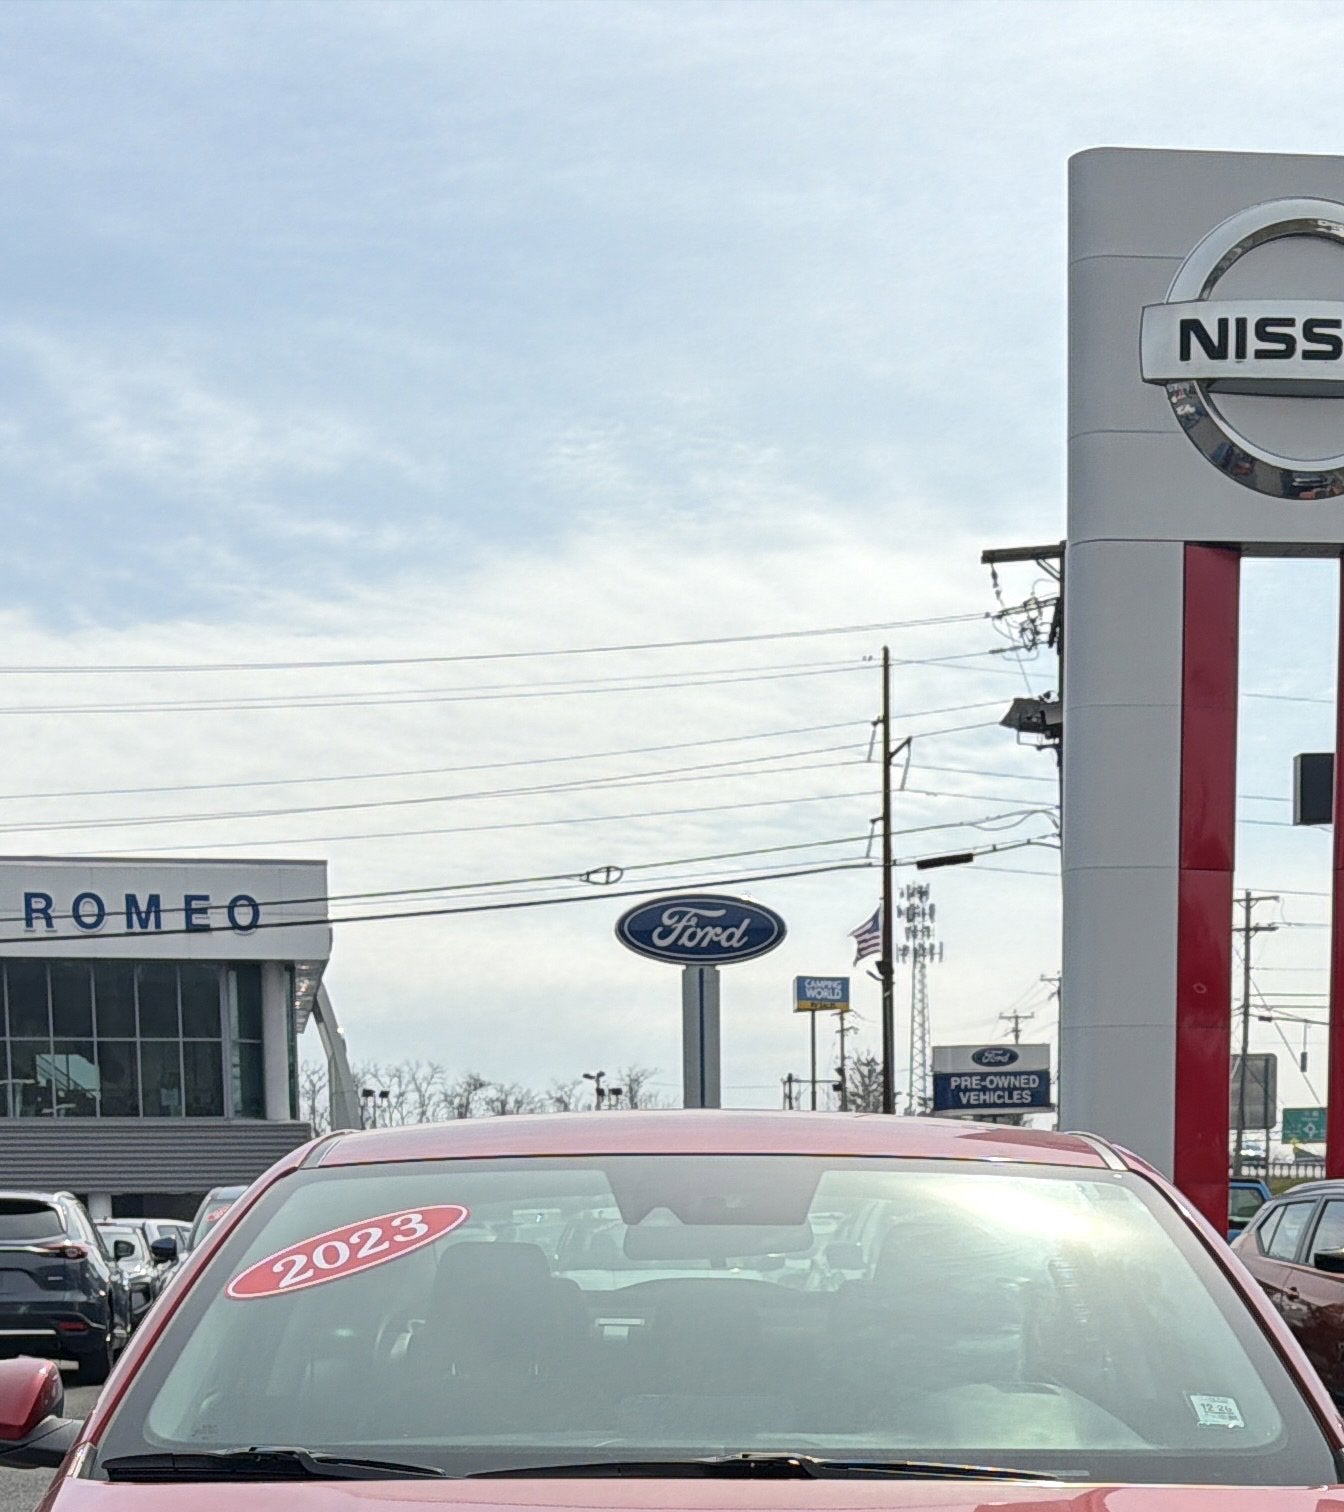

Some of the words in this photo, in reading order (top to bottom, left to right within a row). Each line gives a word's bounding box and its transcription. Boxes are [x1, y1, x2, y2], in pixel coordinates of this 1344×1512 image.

[23, 891, 260, 932] ROMEO
[652, 906, 751, 948] Ford
[805, 988, 842, 1000] WORLD
[981, 1050, 1011, 1063] Ford
[950, 1075, 1040, 1090] PRE-OWNED
[959, 1090, 1032, 1105] VEHICLES
[272, 1213, 429, 1289] 2023
